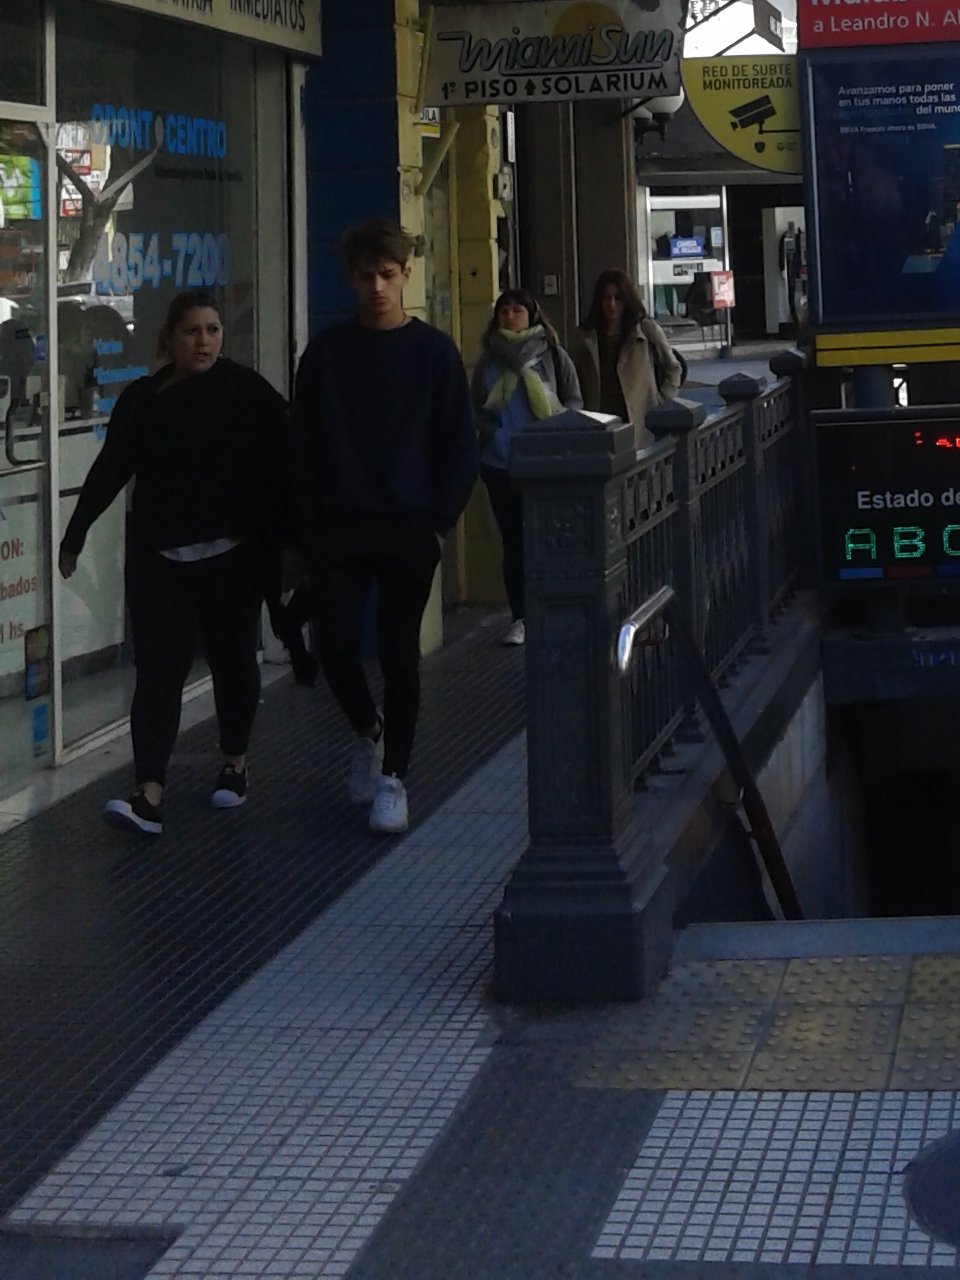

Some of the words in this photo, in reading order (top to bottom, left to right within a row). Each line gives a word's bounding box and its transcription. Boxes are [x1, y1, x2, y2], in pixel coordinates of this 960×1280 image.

[812, 22, 824, 33] a
[830, 13, 909, 31] Leandro
[702, 65, 726, 78] RED
[732, 64, 747, 77] DE
[752, 62, 793, 76] SUBTE
[465, 79, 518, 99] PISO
[541, 72, 668, 97] SOLARIUM
[702, 78, 794, 91] MONITOREADA
[838, 84, 897, 95] Avanzamos
[899, 83, 922, 96] para
[924, 82, 955, 95] poner
[838, 98, 852, 107] en
[854, 96, 870, 106] tus
[872, 94, 907, 105] manos
[909, 92, 939, 104] todas
[941, 92, 956, 103] las
[915, 103, 932, 115] del
[92, 230, 230, 294] 4854-7200
[857, 489, 934, 509] Estado
[845, 528, 876, 560] A
[893, 526, 926, 558] B
